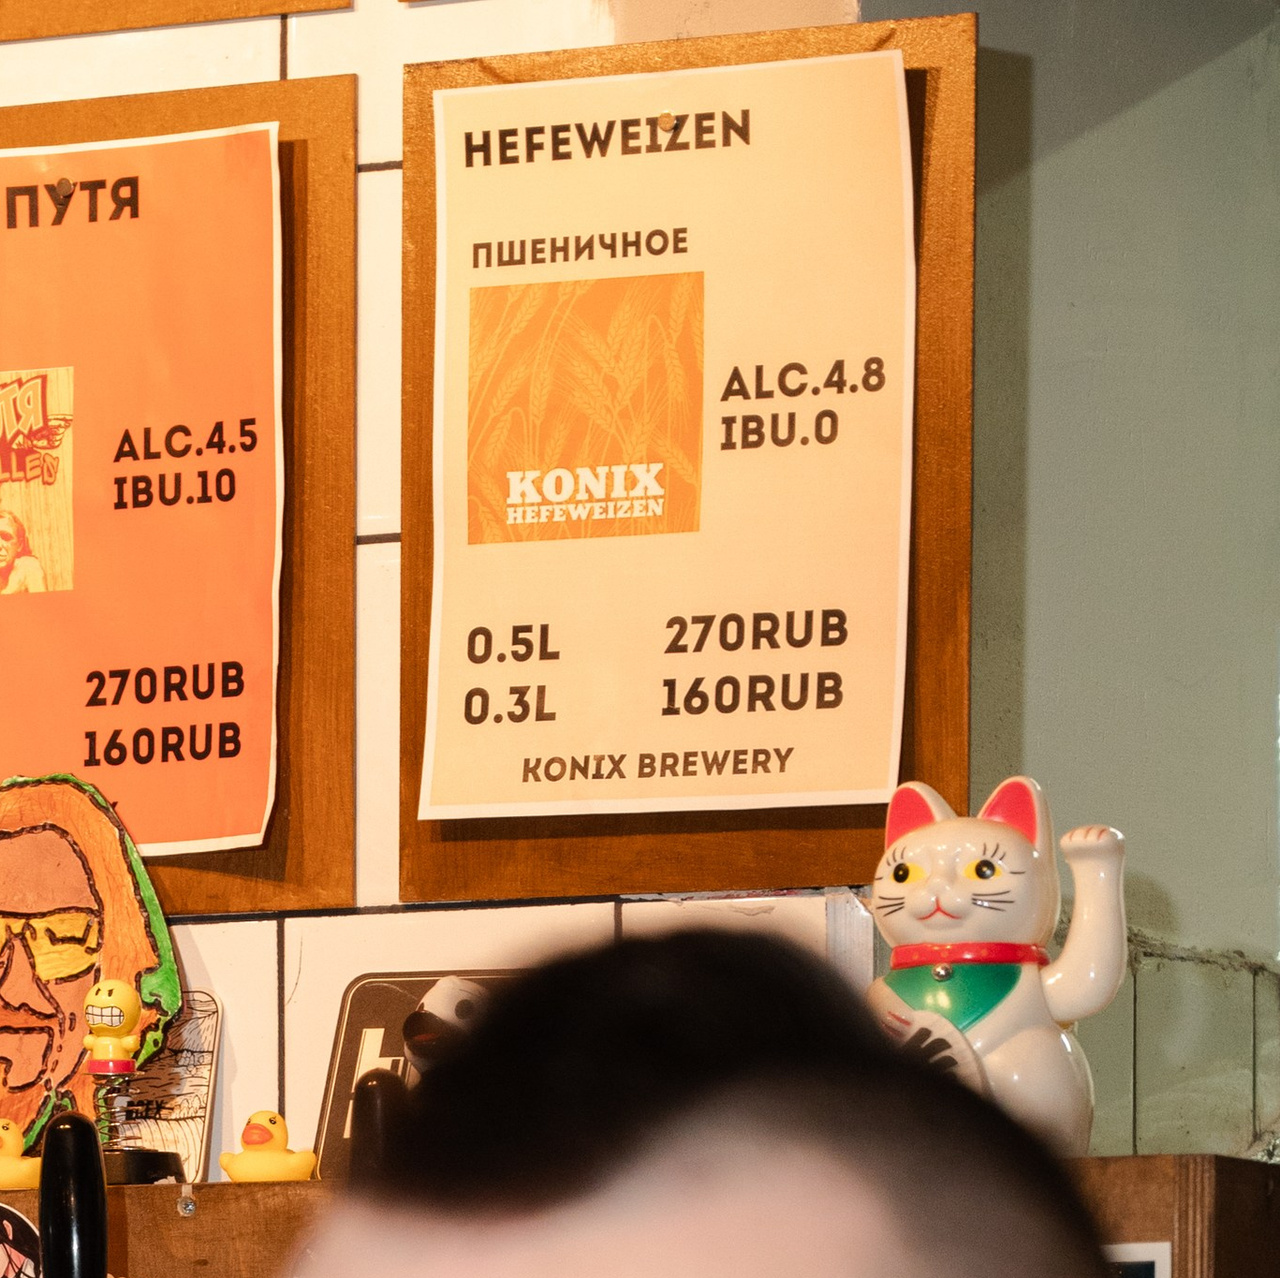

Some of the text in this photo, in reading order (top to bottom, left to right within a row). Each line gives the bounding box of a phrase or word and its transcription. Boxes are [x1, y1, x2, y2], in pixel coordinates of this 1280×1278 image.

[464, 109, 751, 168] HEFEWEIZEN
[5, 175, 140, 230] ПУТЯ
[472, 227, 688, 269] ПШЕНИЧНОЕ
[720, 356, 886, 402] ALC.4.8
[112, 417, 258, 463] ALC.4.5
[720, 409, 839, 451] IBU.0
[113, 467, 236, 511] IBU.10
[506, 463, 664, 504] KONIX
[506, 499, 664, 525] HEFEWEIZEN
[467, 608, 848, 665] 0.5L 270RUB
[85, 660, 245, 708] 270RUB
[464, 671, 843, 725] 0.3L 160RUB
[83, 721, 242, 768] 160RUB
[522, 747, 795, 783] KONIX BREWERY
